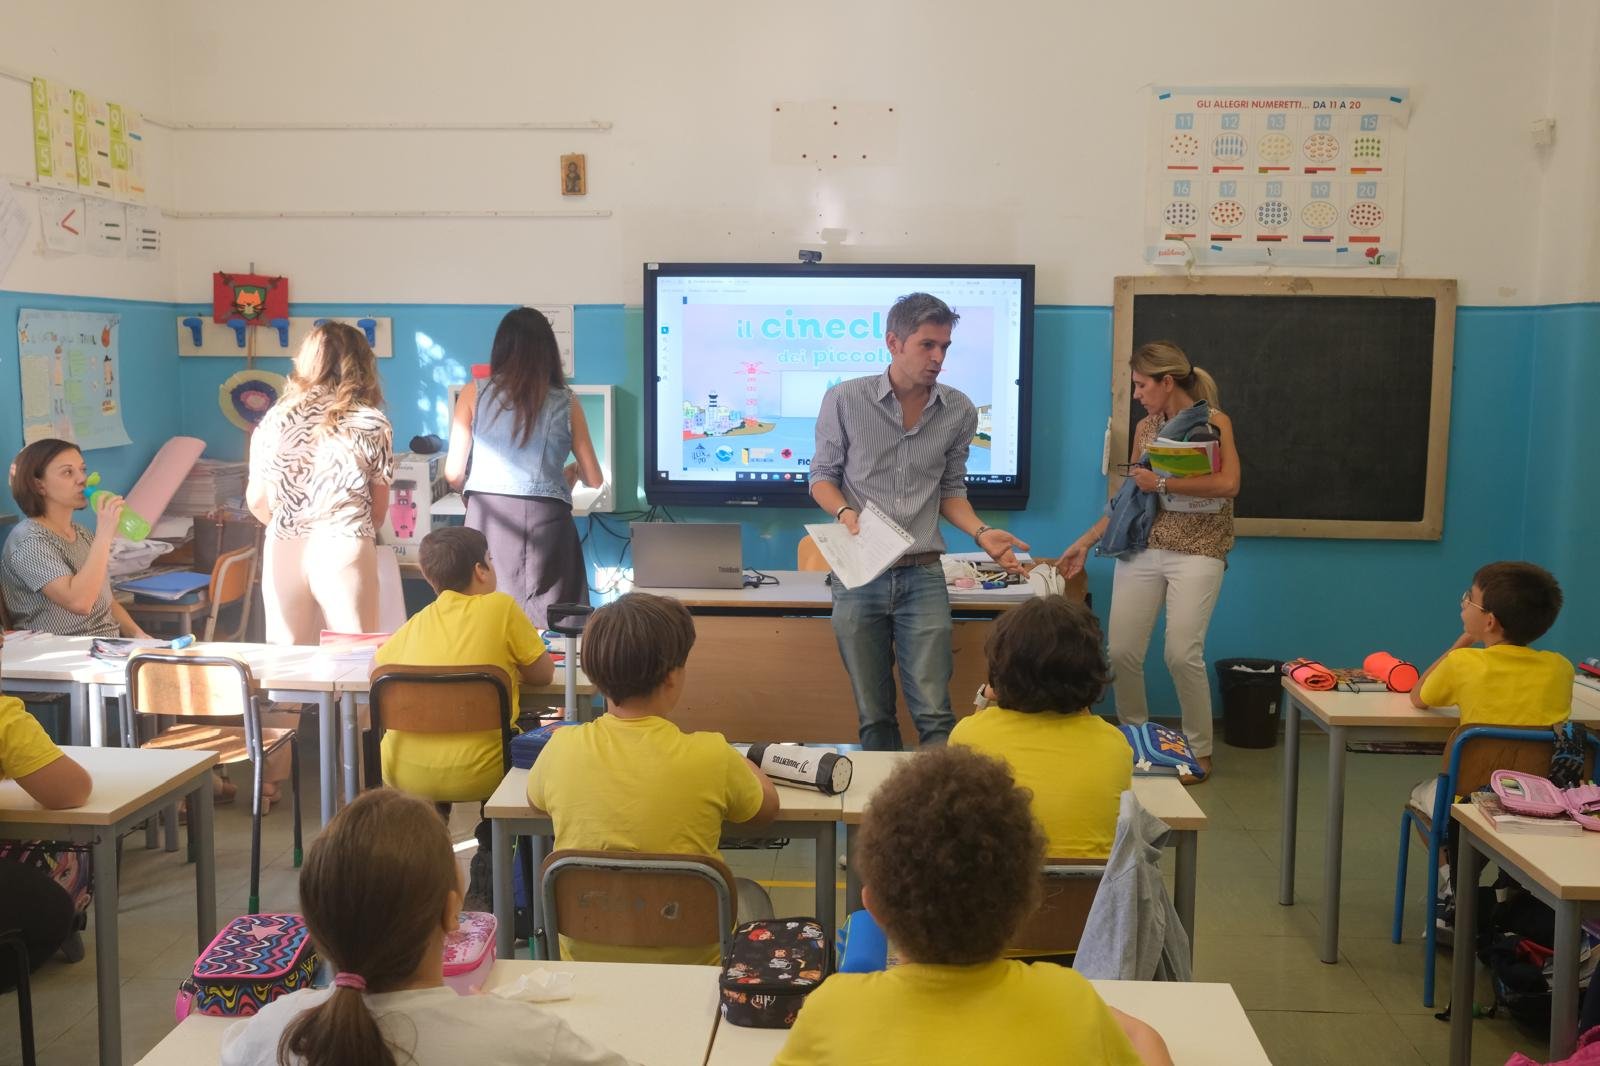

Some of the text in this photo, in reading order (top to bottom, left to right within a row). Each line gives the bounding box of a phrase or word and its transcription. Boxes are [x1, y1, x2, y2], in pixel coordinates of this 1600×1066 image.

[36, 81, 45, 103] 3
[75, 96, 85, 115] 6
[1196, 100, 1361, 110] GLI ALLEGRI NUMERETTI... DA 11 A 20
[38, 114, 48, 133] 4
[111, 110, 120, 128] 9
[1179, 117, 1192, 128] 11
[1224, 117, 1238, 128] 12
[1271, 117, 1284, 128] 13
[1316, 117, 1330, 128] 14
[1363, 117, 1375, 129] 15
[40, 149, 49, 167] 5
[115, 143, 126, 162] 10
[79, 158, 88, 178] 8
[1175, 183, 1189, 195] 16
[1221, 183, 1235, 195] 17
[1268, 184, 1281, 195] 18
[1313, 185, 1328, 196] 19
[1358, 184, 1375, 196] 20
[737, 309, 883, 339] il cinecl
[777, 348, 807, 363] dei
[772, 755, 800, 769] JUVENTUS
